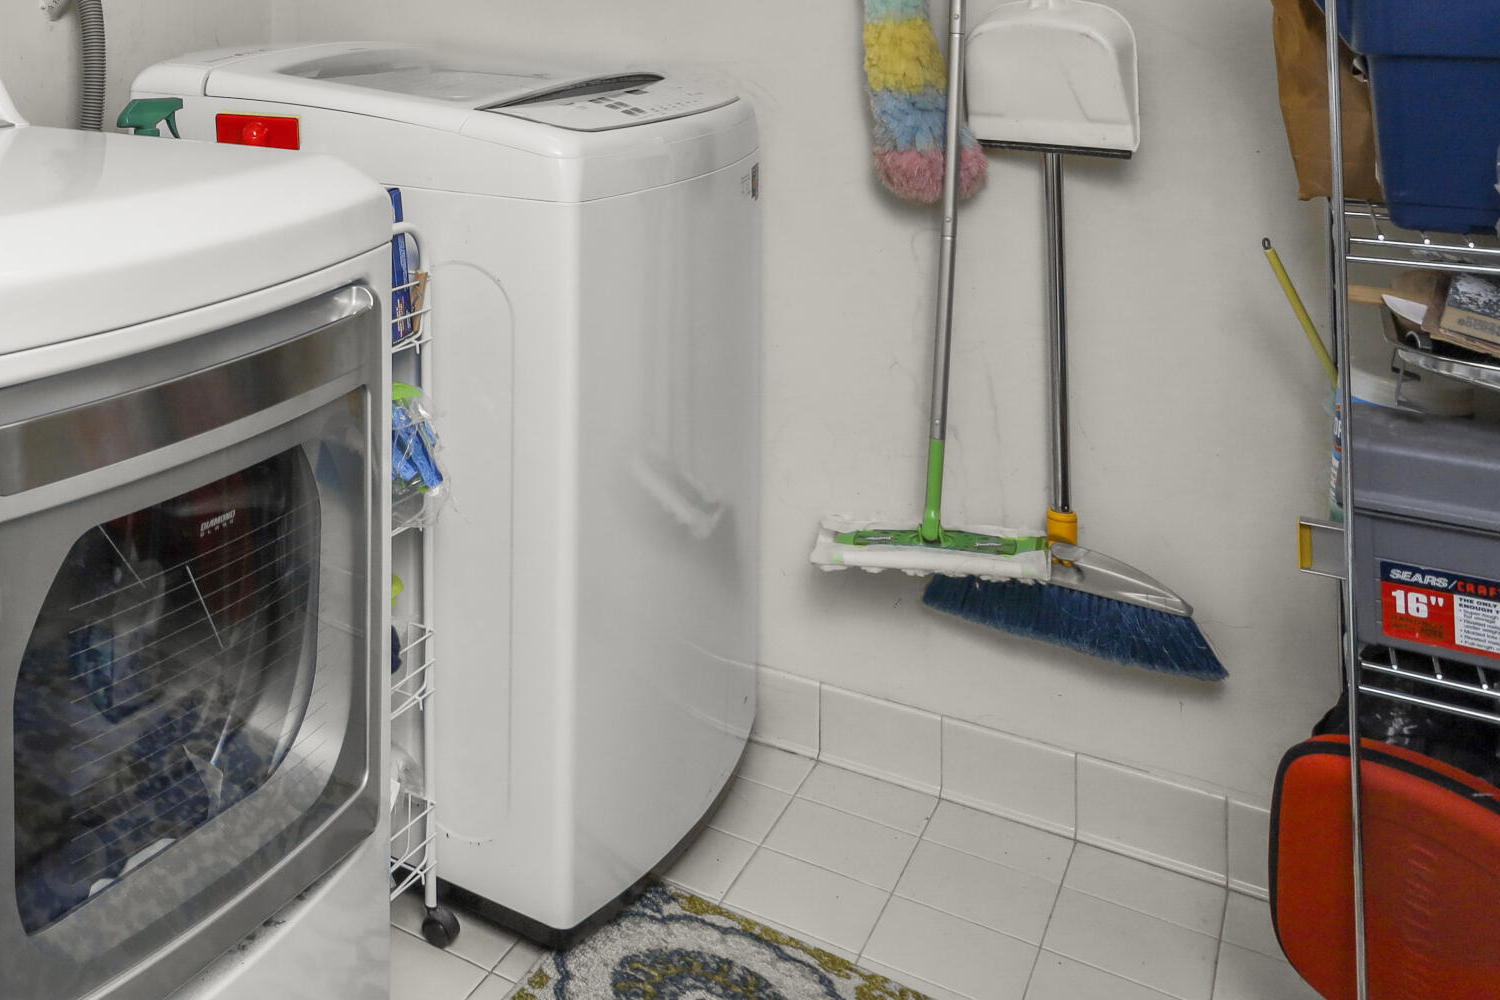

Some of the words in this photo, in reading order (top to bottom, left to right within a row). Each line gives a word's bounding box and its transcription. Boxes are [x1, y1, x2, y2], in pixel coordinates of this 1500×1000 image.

[1391, 589, 1444, 618] 16"
[1459, 603, 1493, 613] ENOUGH
[1476, 600, 1497, 609] ONLY
